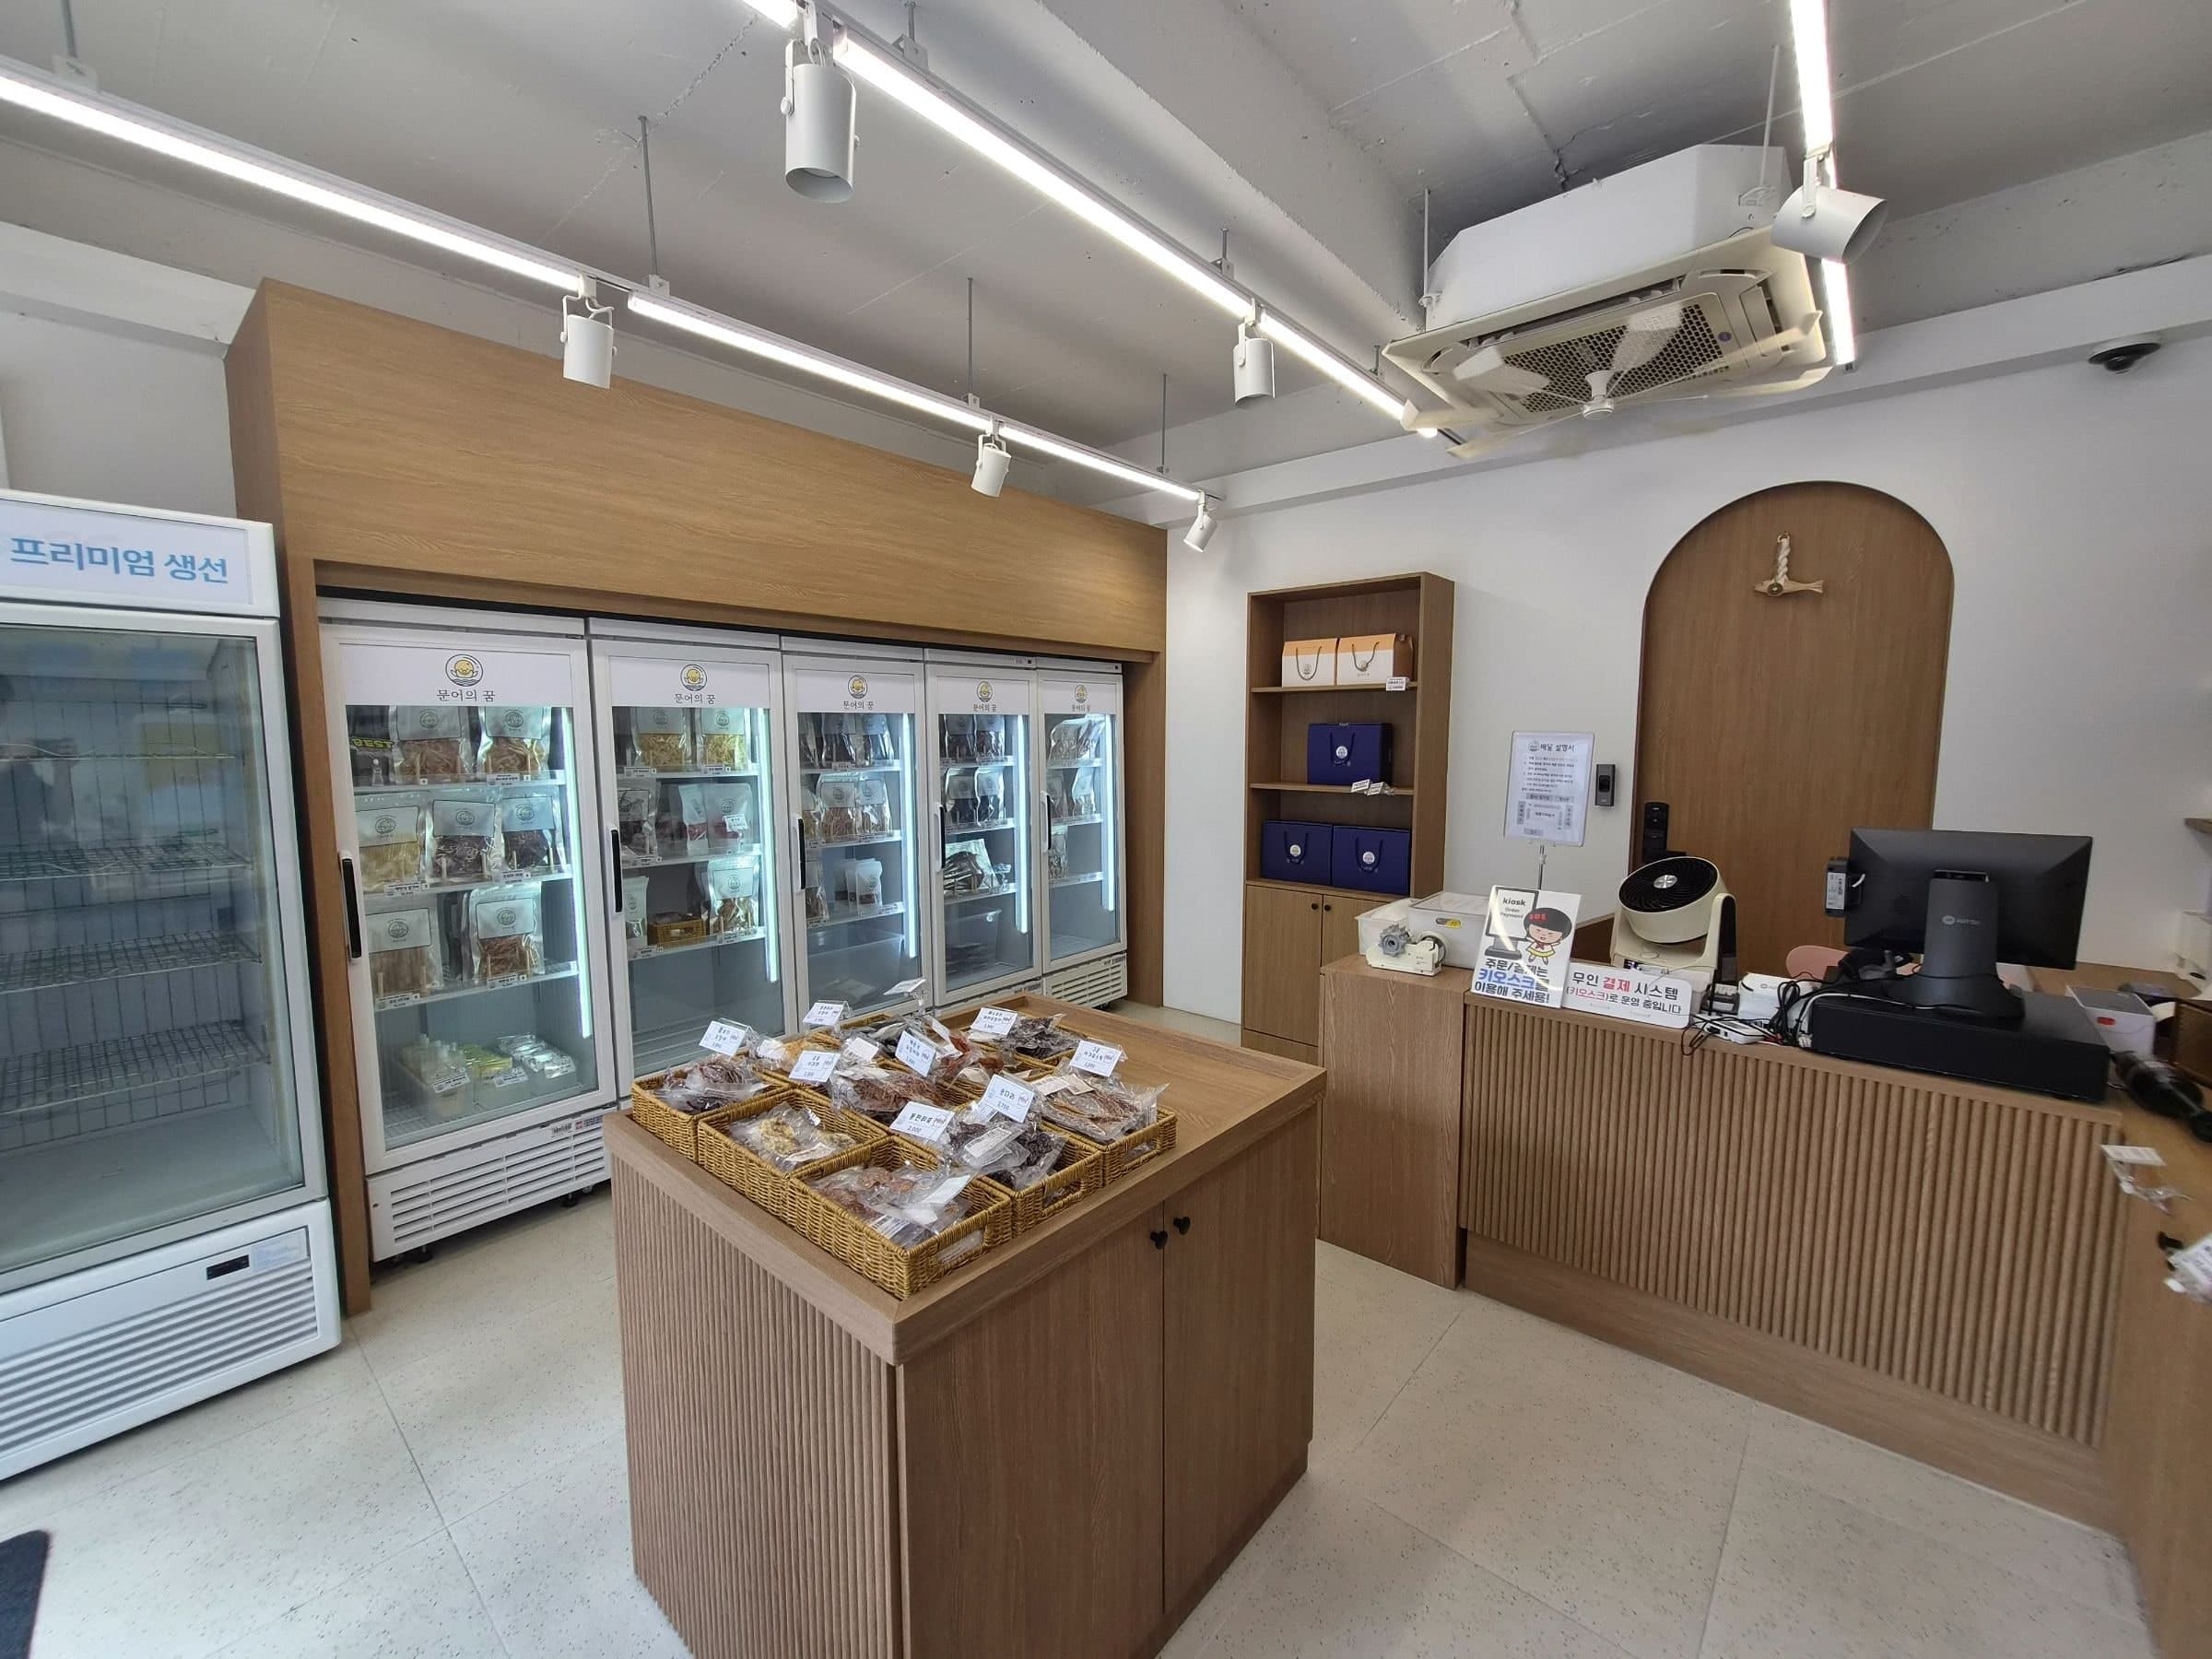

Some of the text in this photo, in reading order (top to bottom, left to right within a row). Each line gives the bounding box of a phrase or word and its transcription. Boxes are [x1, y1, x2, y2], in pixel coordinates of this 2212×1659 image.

[10, 537, 229, 583] 프리미엄 생선
[436, 688, 496, 703] 문어의 꿈
[674, 693, 716, 705] 문어의 꿈
[842, 700, 875, 711] 문어의 꿈
[972, 703, 991, 712] 문어의
[1502, 897, 1526, 907] kiosk
[1571, 971, 1678, 1001] 무인 결제 시스템
[1512, 988, 1550, 1004] 주세용!
[1621, 995, 1640, 1007] 운영
[1642, 999, 1682, 1015] 중입니다
